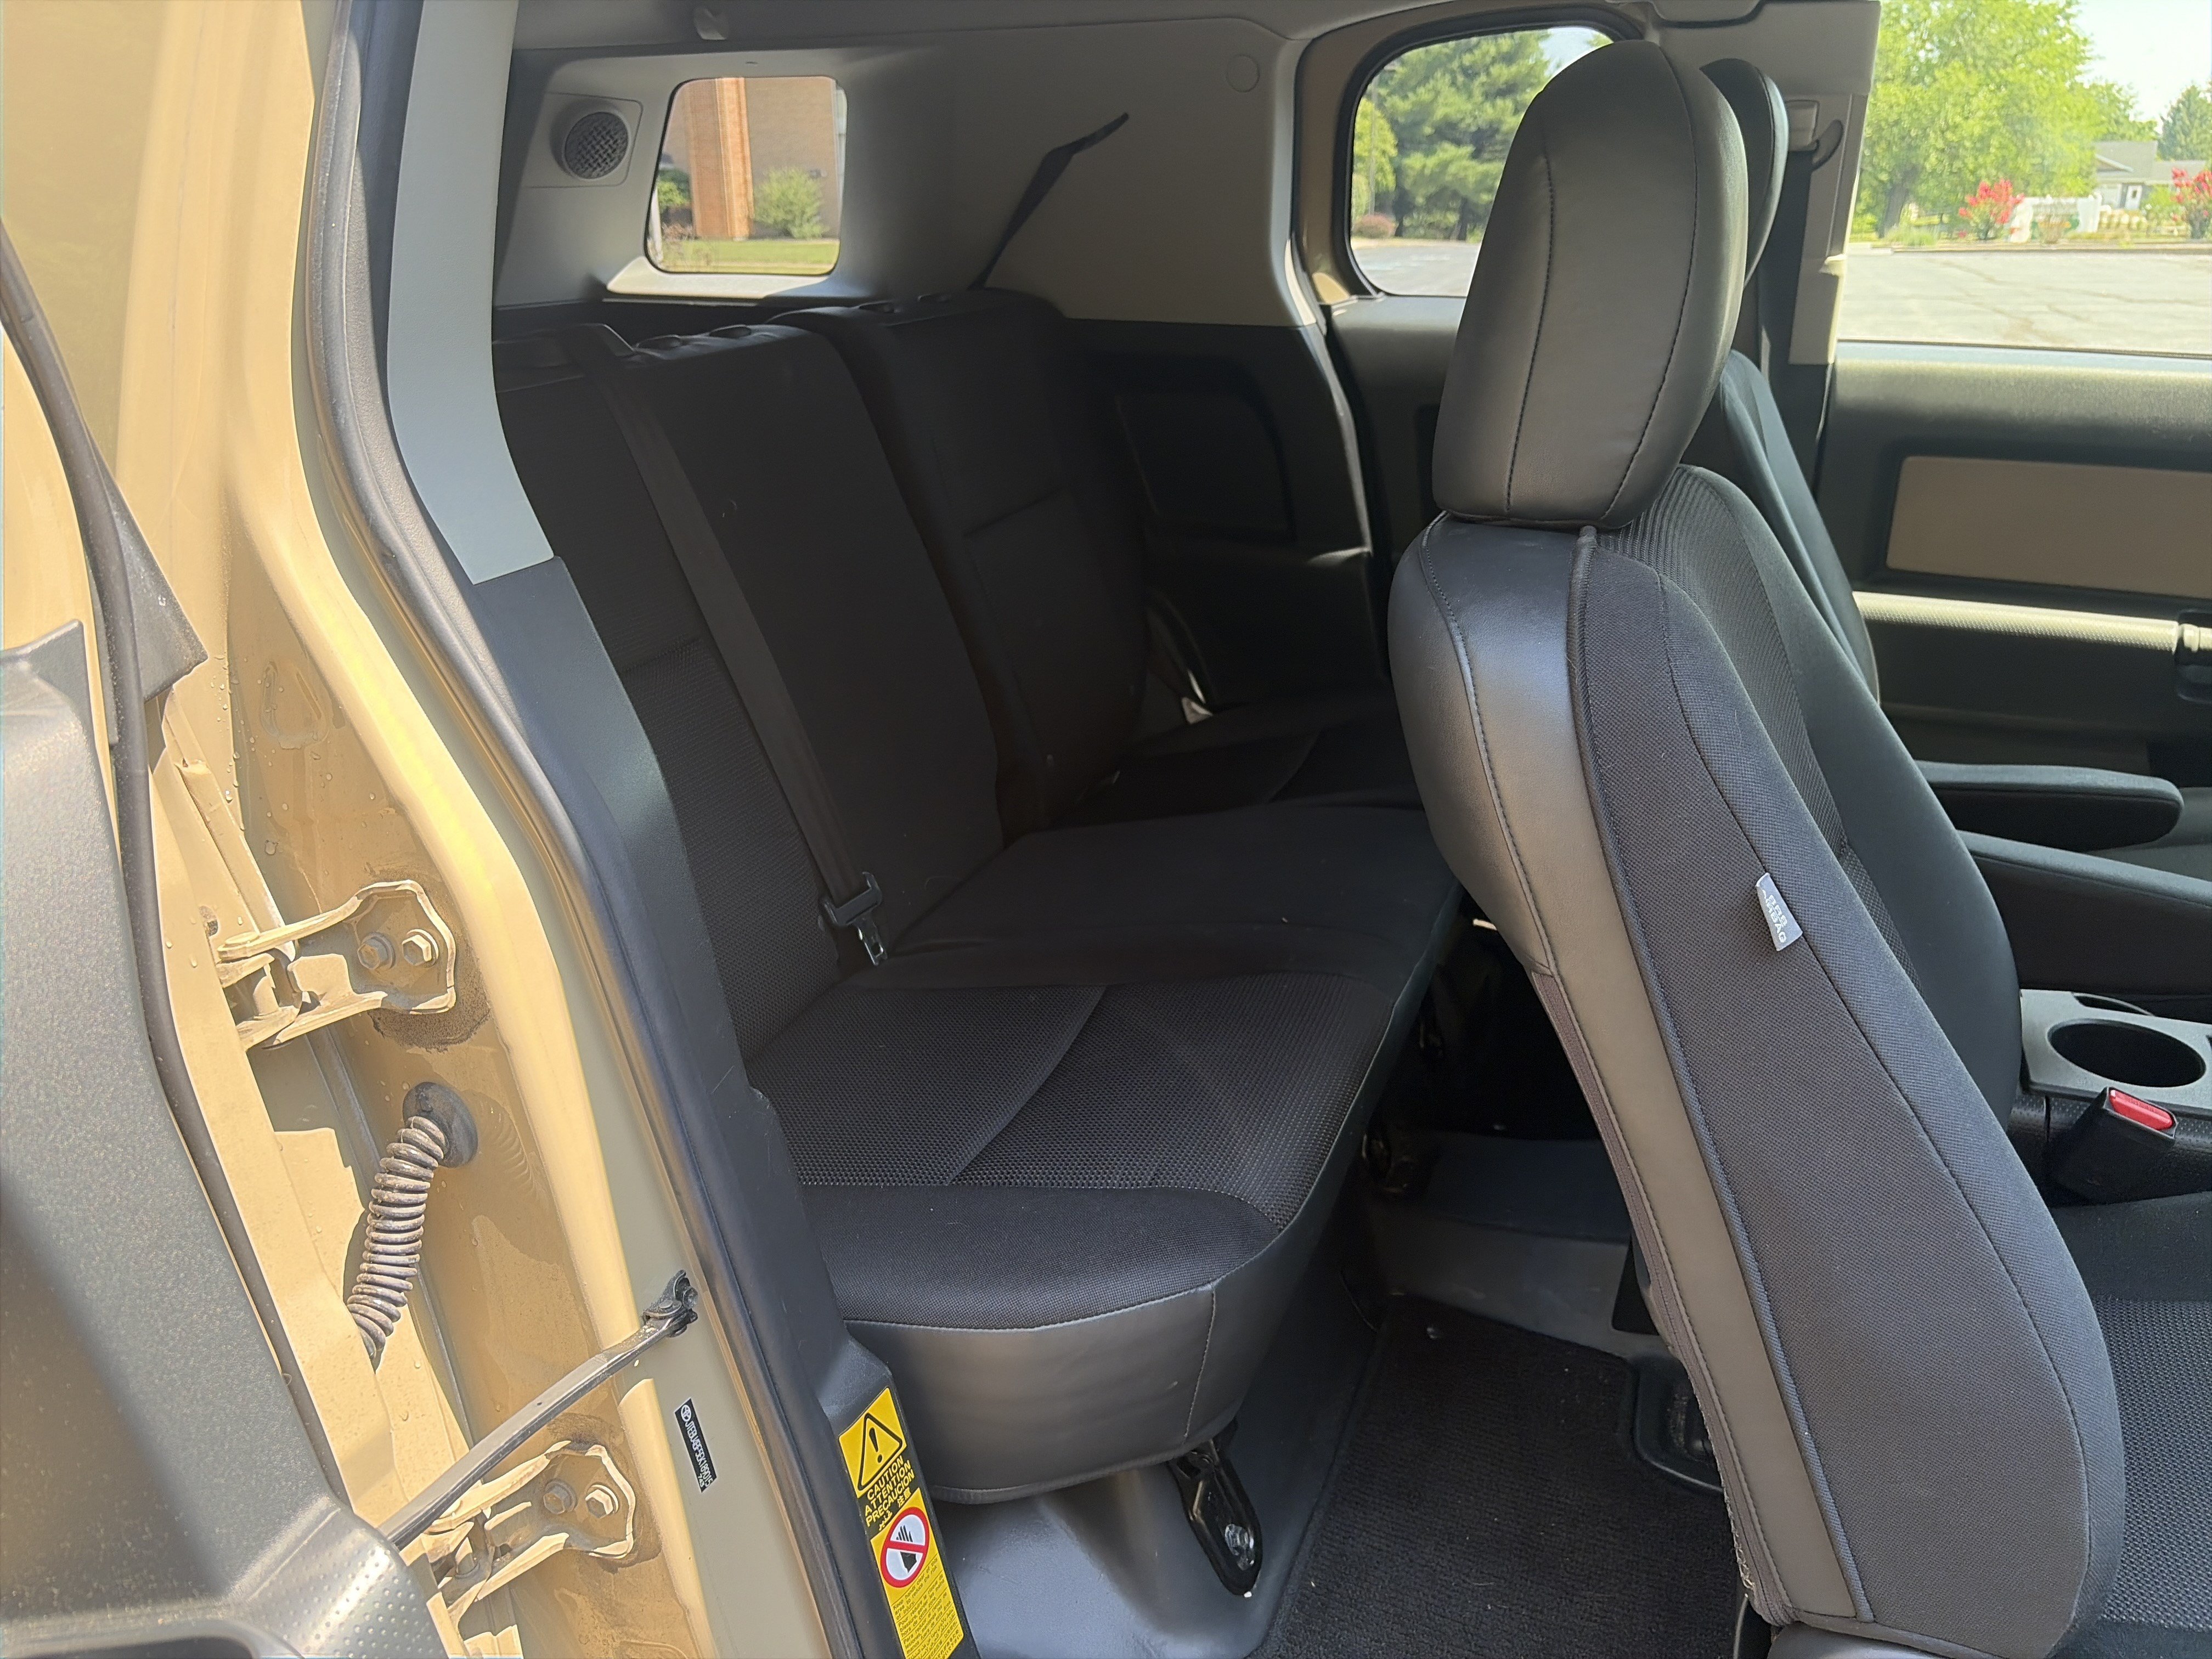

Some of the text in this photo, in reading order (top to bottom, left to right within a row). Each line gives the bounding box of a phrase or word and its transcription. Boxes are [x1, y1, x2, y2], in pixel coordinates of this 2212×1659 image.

[685, 1420, 713, 1487] JTEBU4BF5EK189015
[867, 1455, 904, 1500] CAUTION
[865, 1460, 911, 1516] ATTENTION
